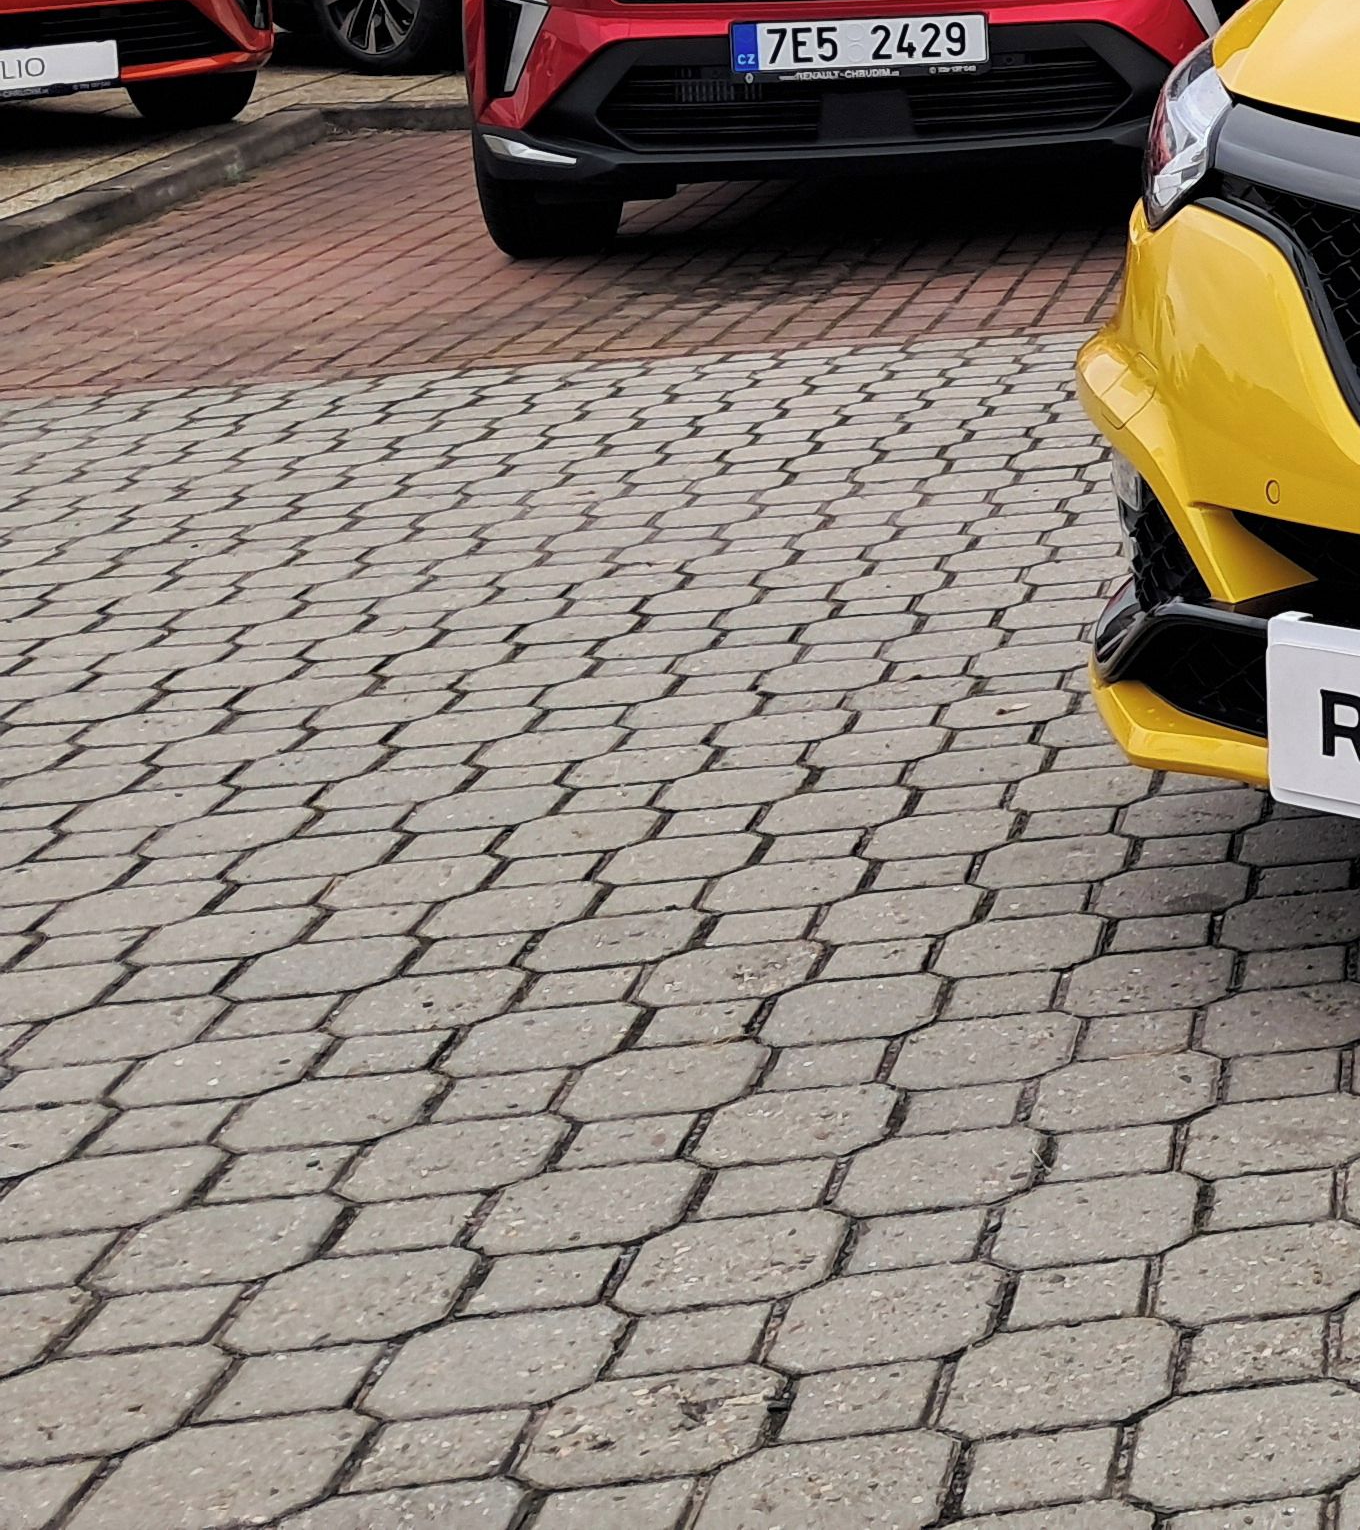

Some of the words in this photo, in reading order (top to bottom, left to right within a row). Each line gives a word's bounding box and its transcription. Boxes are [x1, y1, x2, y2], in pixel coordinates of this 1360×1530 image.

[766, 27, 839, 64] 7E5
[871, 22, 966, 61] 2429
[737, 54, 756, 66] CZ
